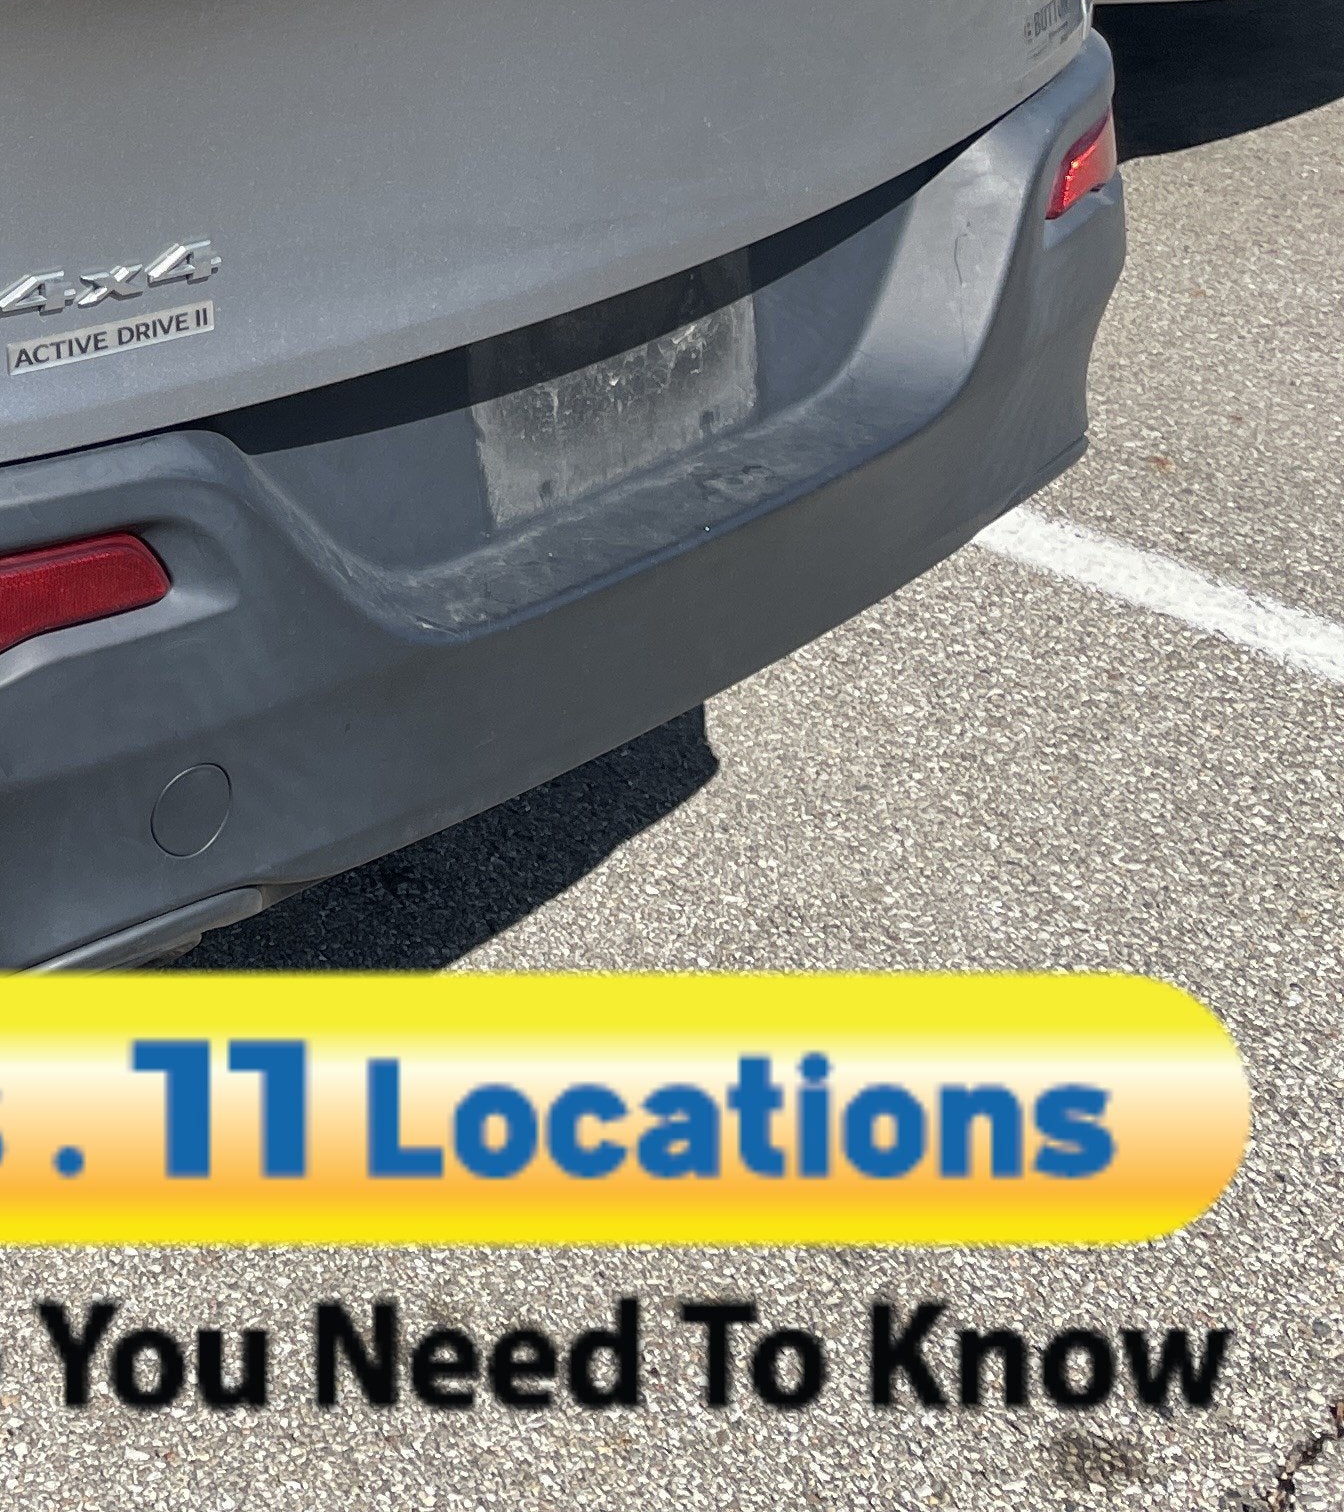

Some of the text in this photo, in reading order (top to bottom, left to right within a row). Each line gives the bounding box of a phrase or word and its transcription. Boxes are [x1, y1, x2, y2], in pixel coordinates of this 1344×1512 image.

[14, 307, 209, 368] ACTIVE DRIVE II
